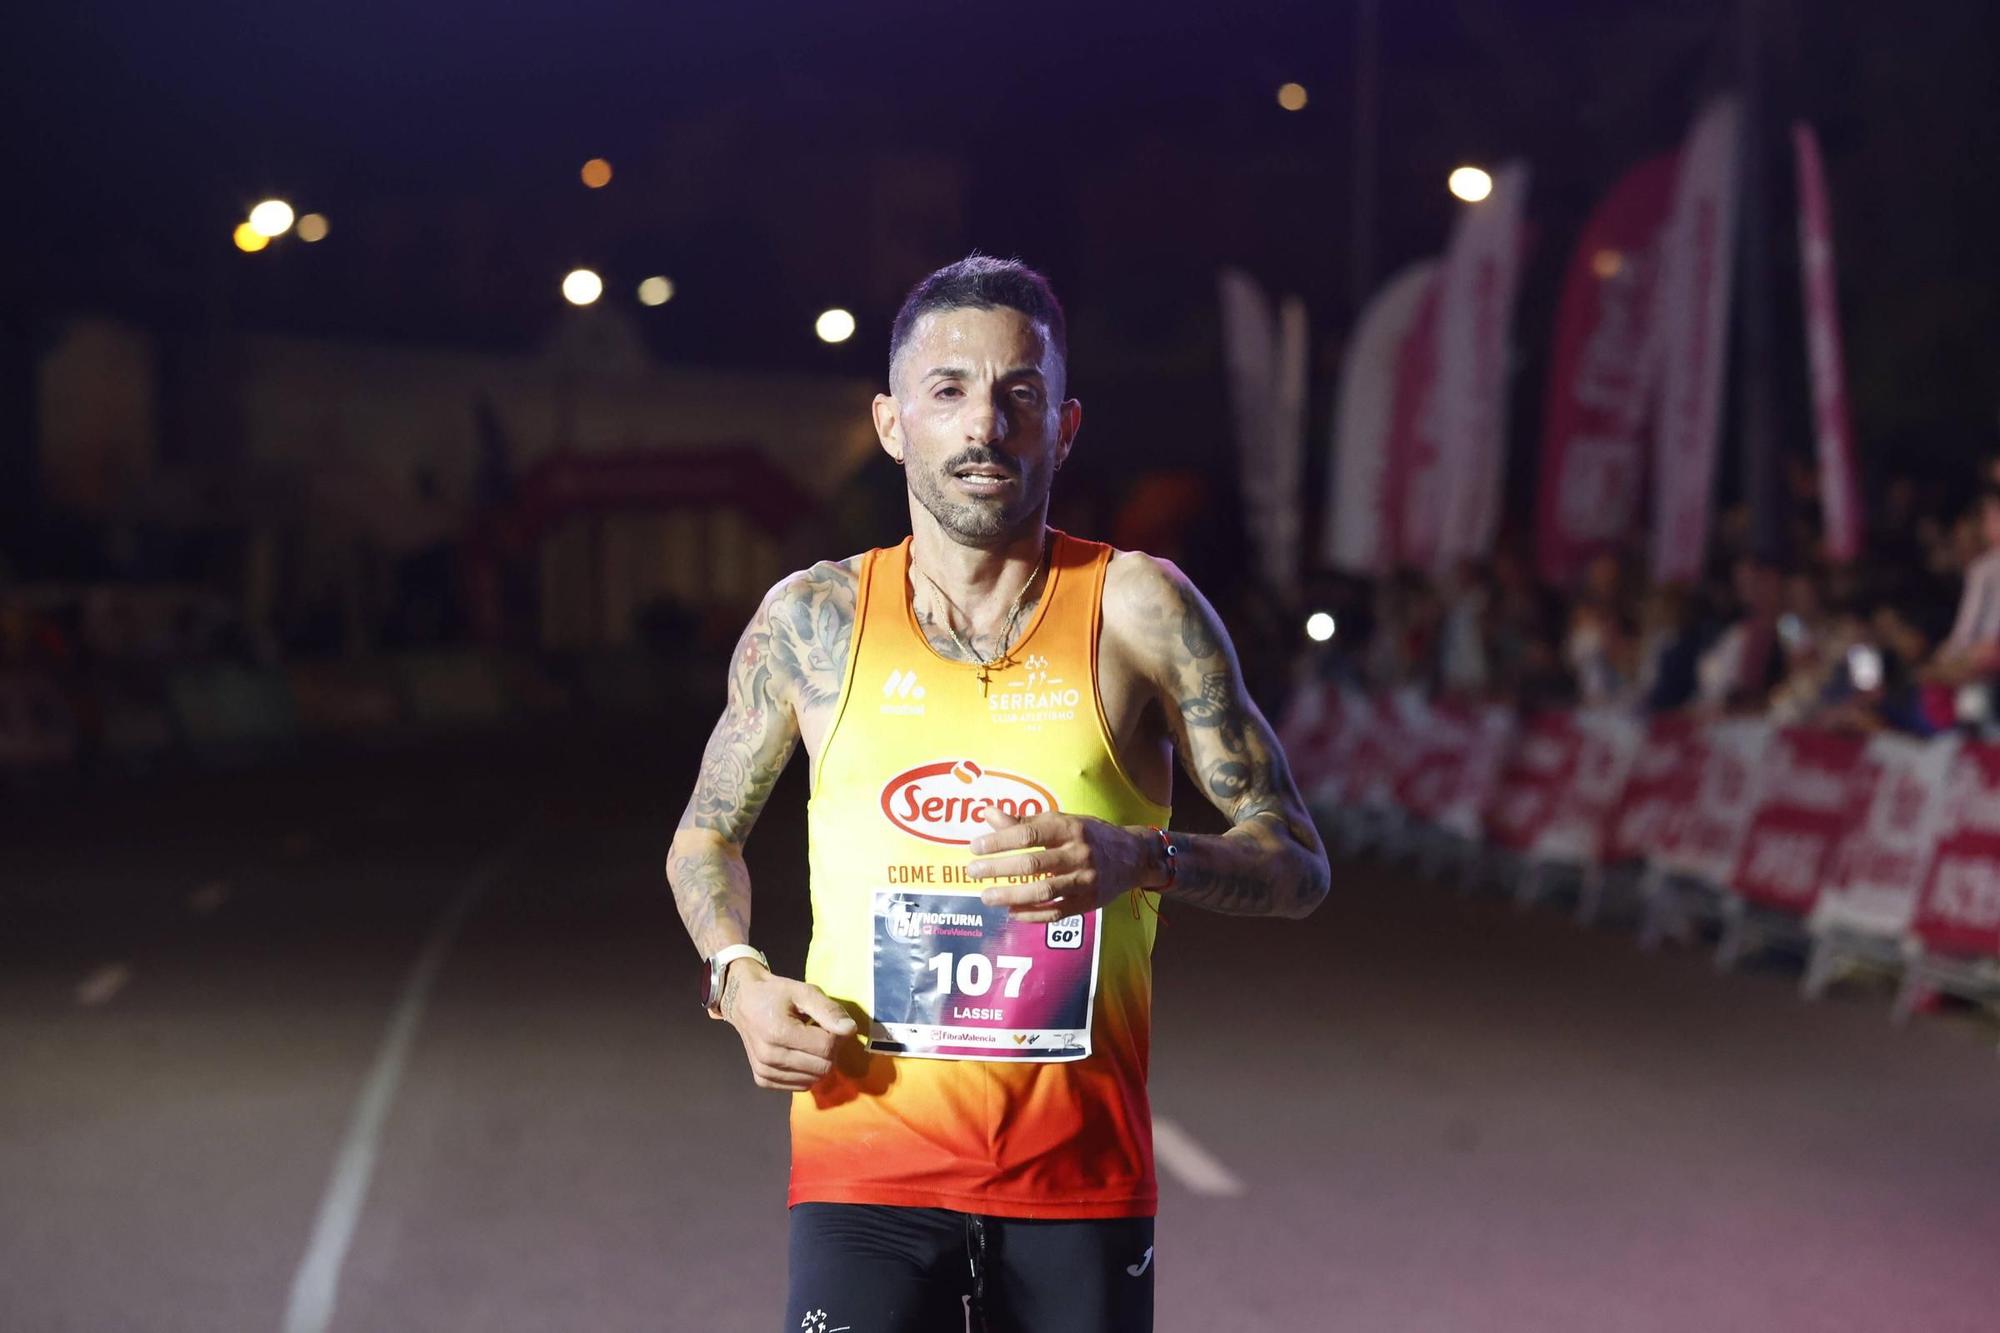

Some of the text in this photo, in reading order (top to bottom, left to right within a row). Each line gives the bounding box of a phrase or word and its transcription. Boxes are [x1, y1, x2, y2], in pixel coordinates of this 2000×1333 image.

[989, 688, 1079, 710] SERRANO
[888, 865, 935, 884] COME
[922, 912, 983, 927] NOCTURNA
[928, 951, 1033, 998] 107
[953, 1006, 1003, 1021] LASSIE
[943, 1031, 997, 1043] FibraValencia
